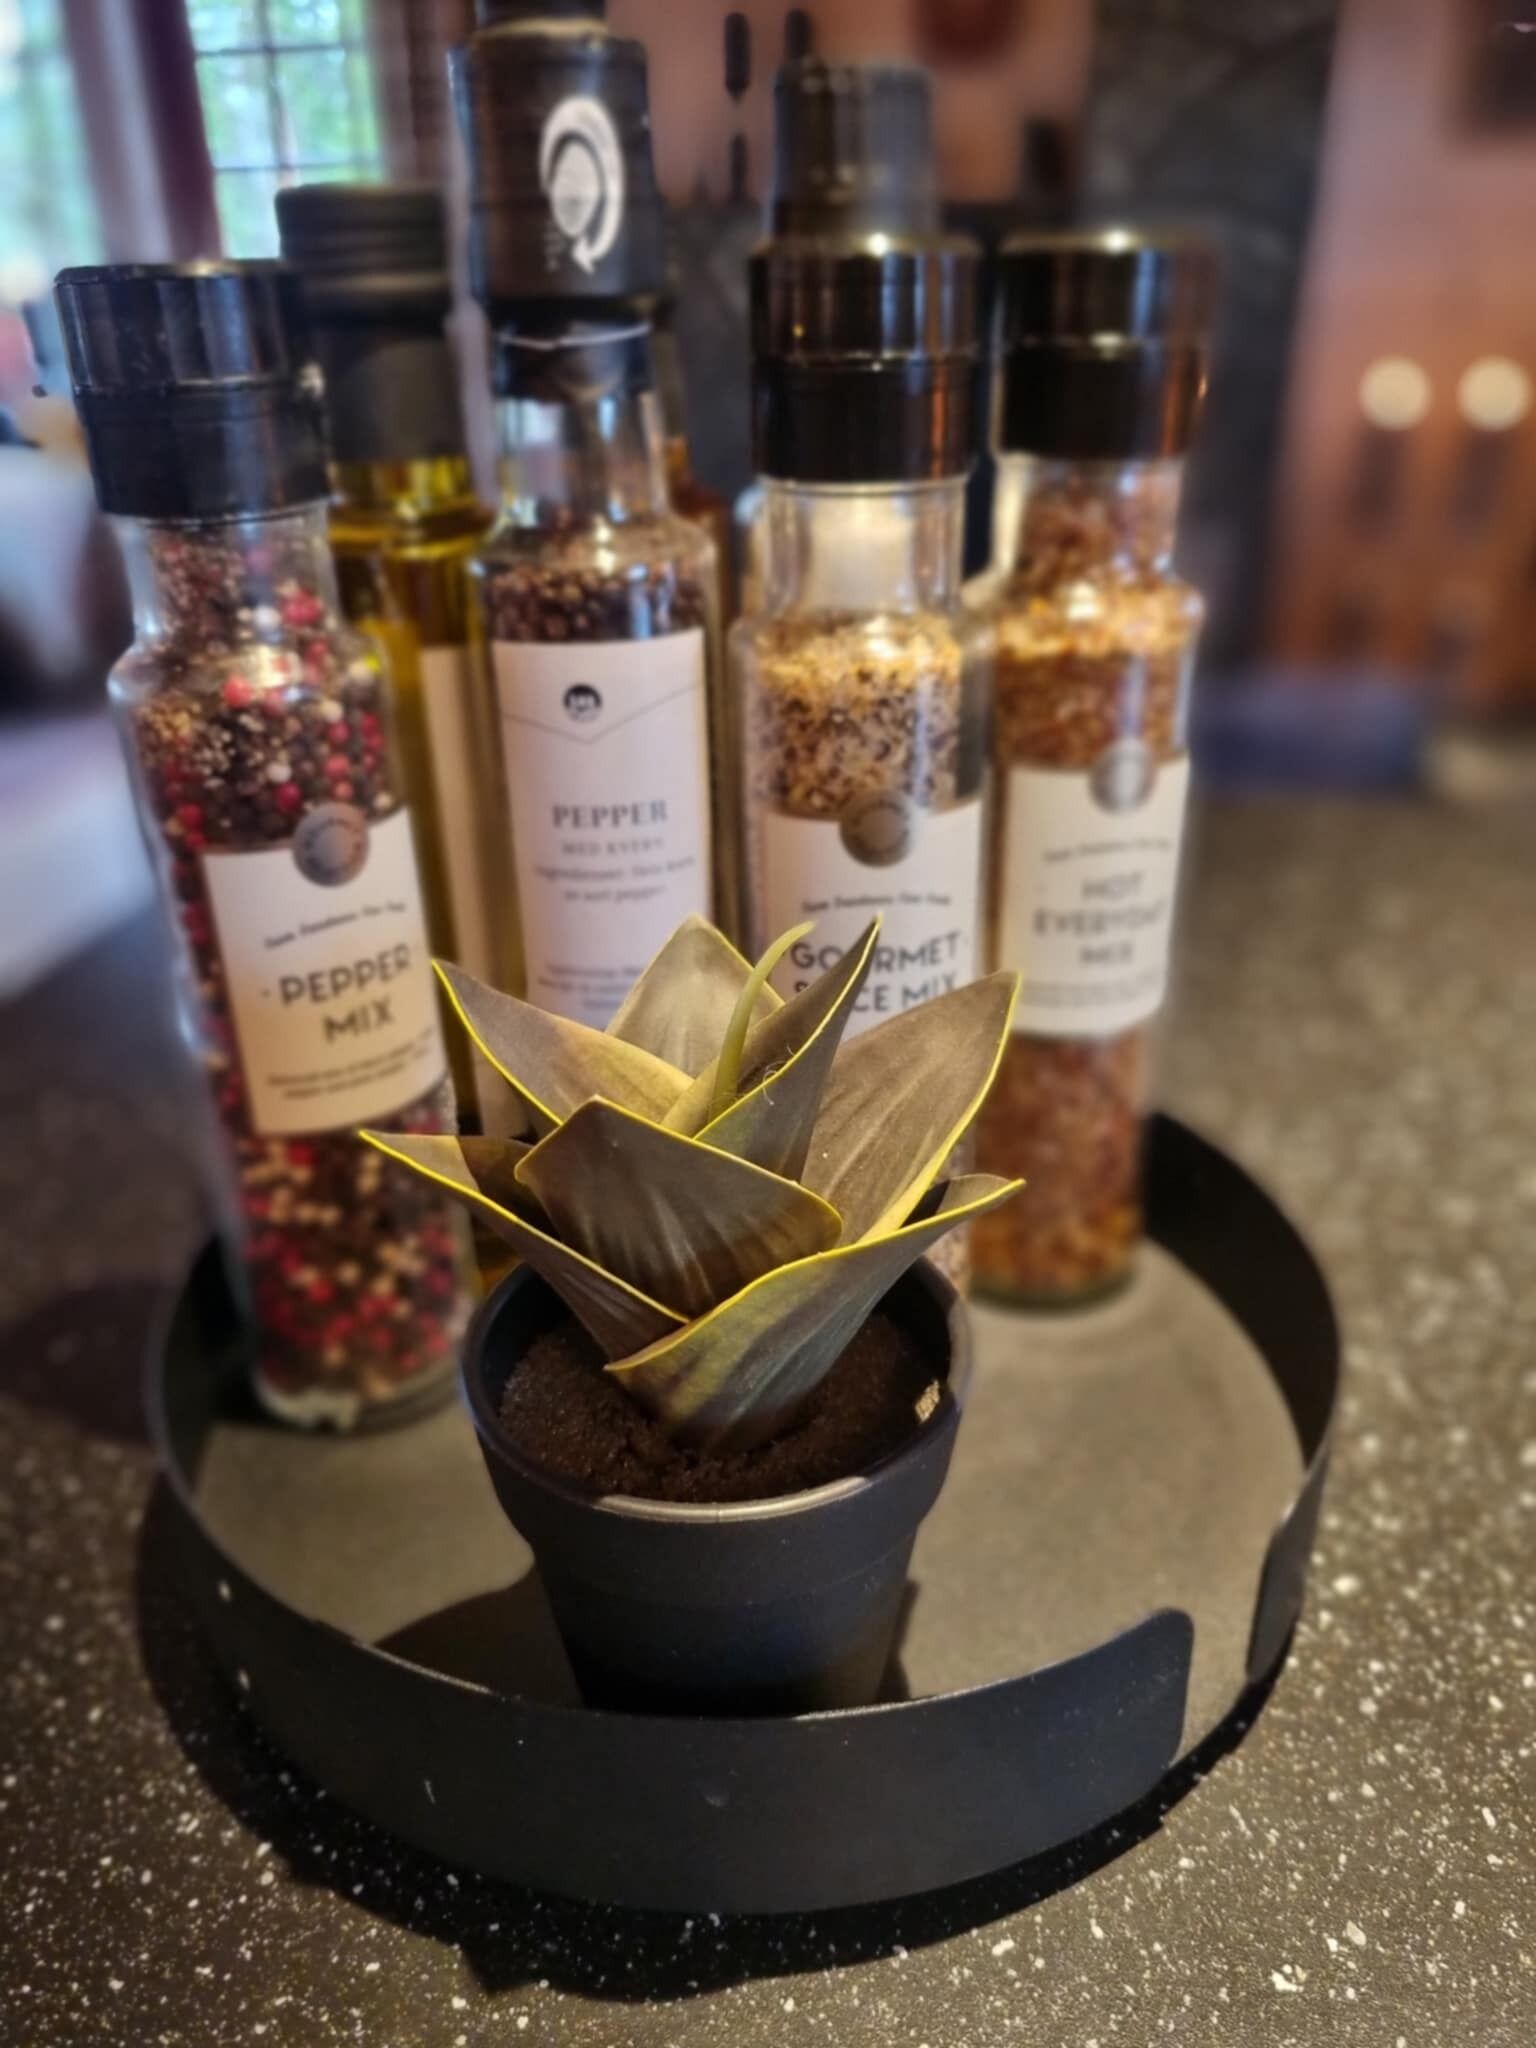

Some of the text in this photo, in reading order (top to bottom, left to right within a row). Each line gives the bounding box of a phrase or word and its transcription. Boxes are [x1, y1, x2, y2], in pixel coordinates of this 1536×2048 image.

[552, 800, 668, 829] PEPPER
[789, 930, 961, 973] GORMET
[278, 944, 411, 1005] PEPPER
[793, 979, 891, 1013] SCE
[323, 1000, 395, 1044] MIX
